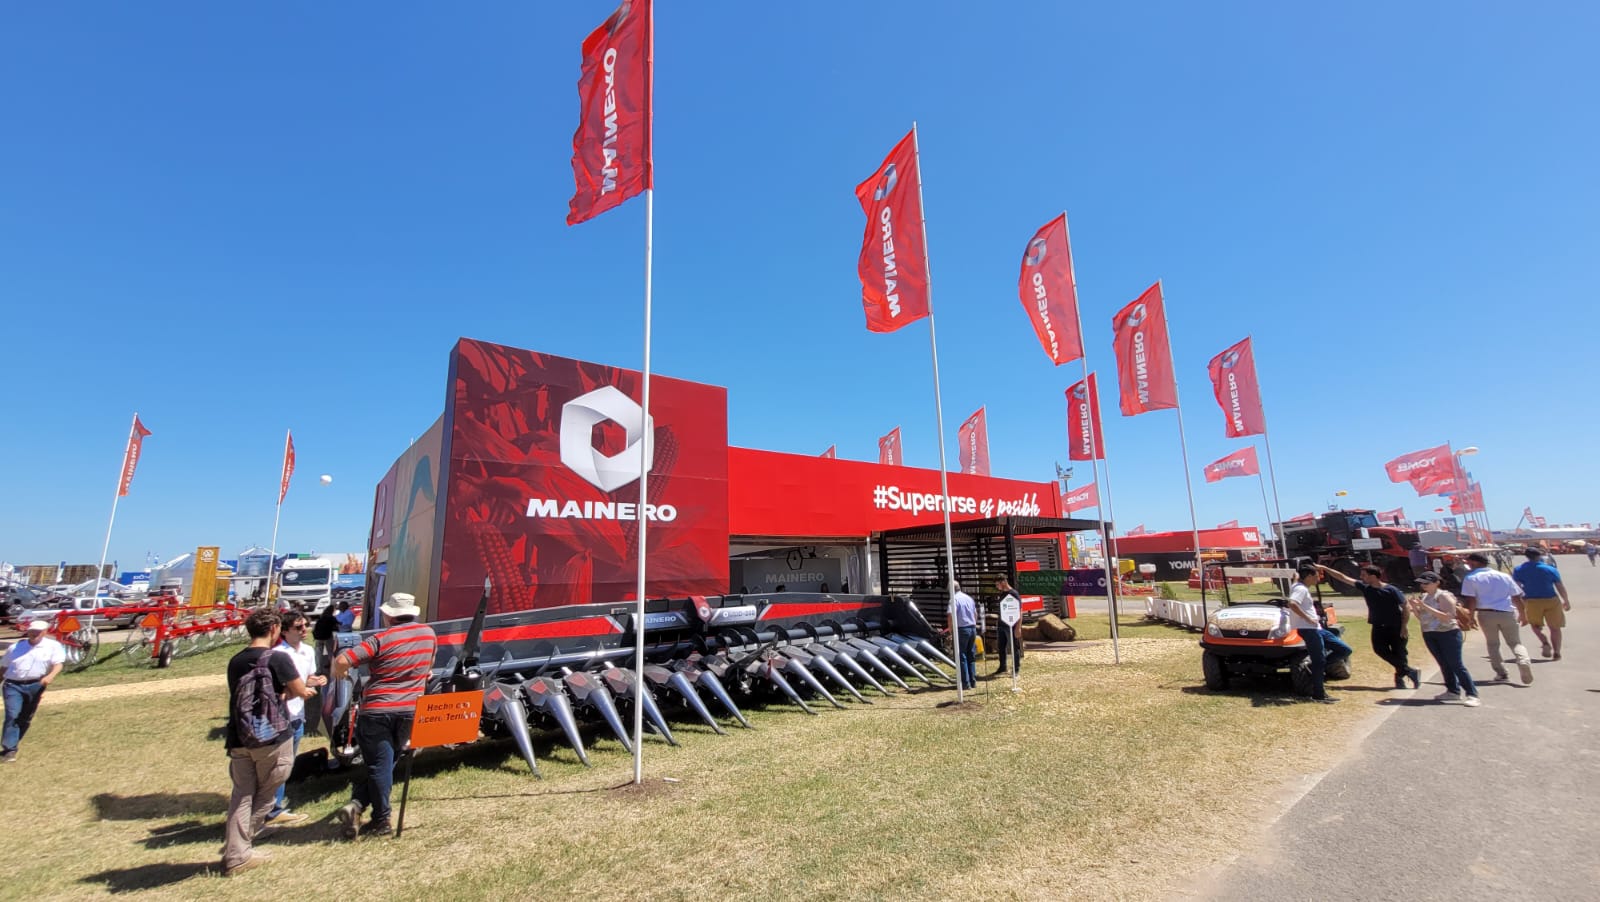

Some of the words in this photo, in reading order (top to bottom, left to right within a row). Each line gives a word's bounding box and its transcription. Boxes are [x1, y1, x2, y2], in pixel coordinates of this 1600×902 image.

[526, 498, 677, 522] MAINERO
[873, 485, 977, 516] #Superarse
[980, 498, 995, 518] es
[996, 492, 1041, 517] posible
[766, 572, 825, 583] MAINERO
